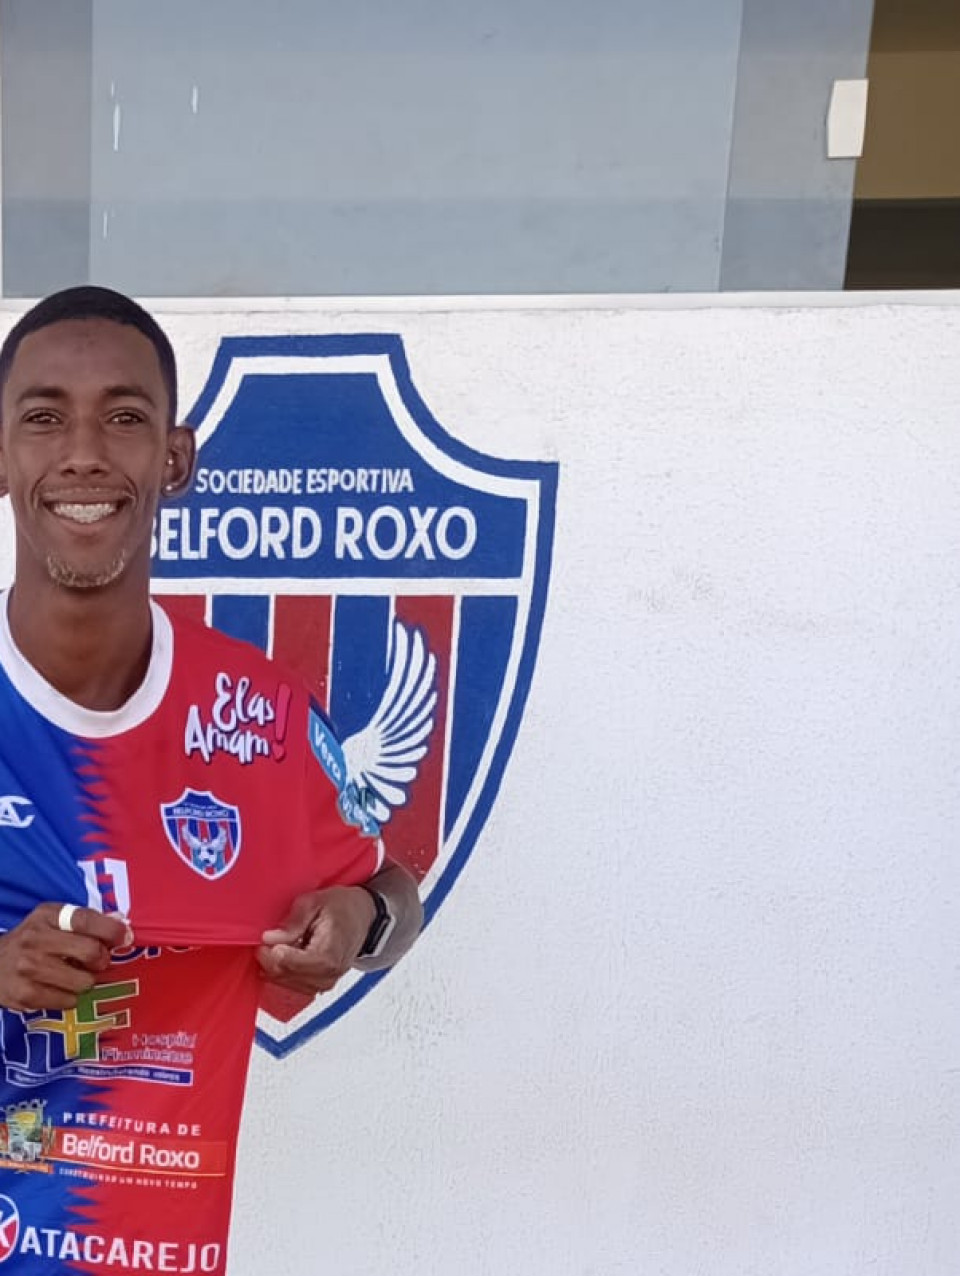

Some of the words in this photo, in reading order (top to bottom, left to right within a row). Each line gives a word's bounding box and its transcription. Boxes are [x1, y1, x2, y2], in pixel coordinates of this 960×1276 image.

[195, 467, 302, 495] SOCIEDADE
[306, 467, 414, 494] ESPORTIVA
[335, 505, 477, 560] ROXO
[212, 672, 275, 733] Elas
[63, 1111, 171, 1135] PREFEITURA
[177, 1124, 202, 1136] DE
[62, 1133, 135, 1164] Belford
[140, 1144, 200, 1169] Roxo
[20, 1226, 221, 1273] ATACAREJO
